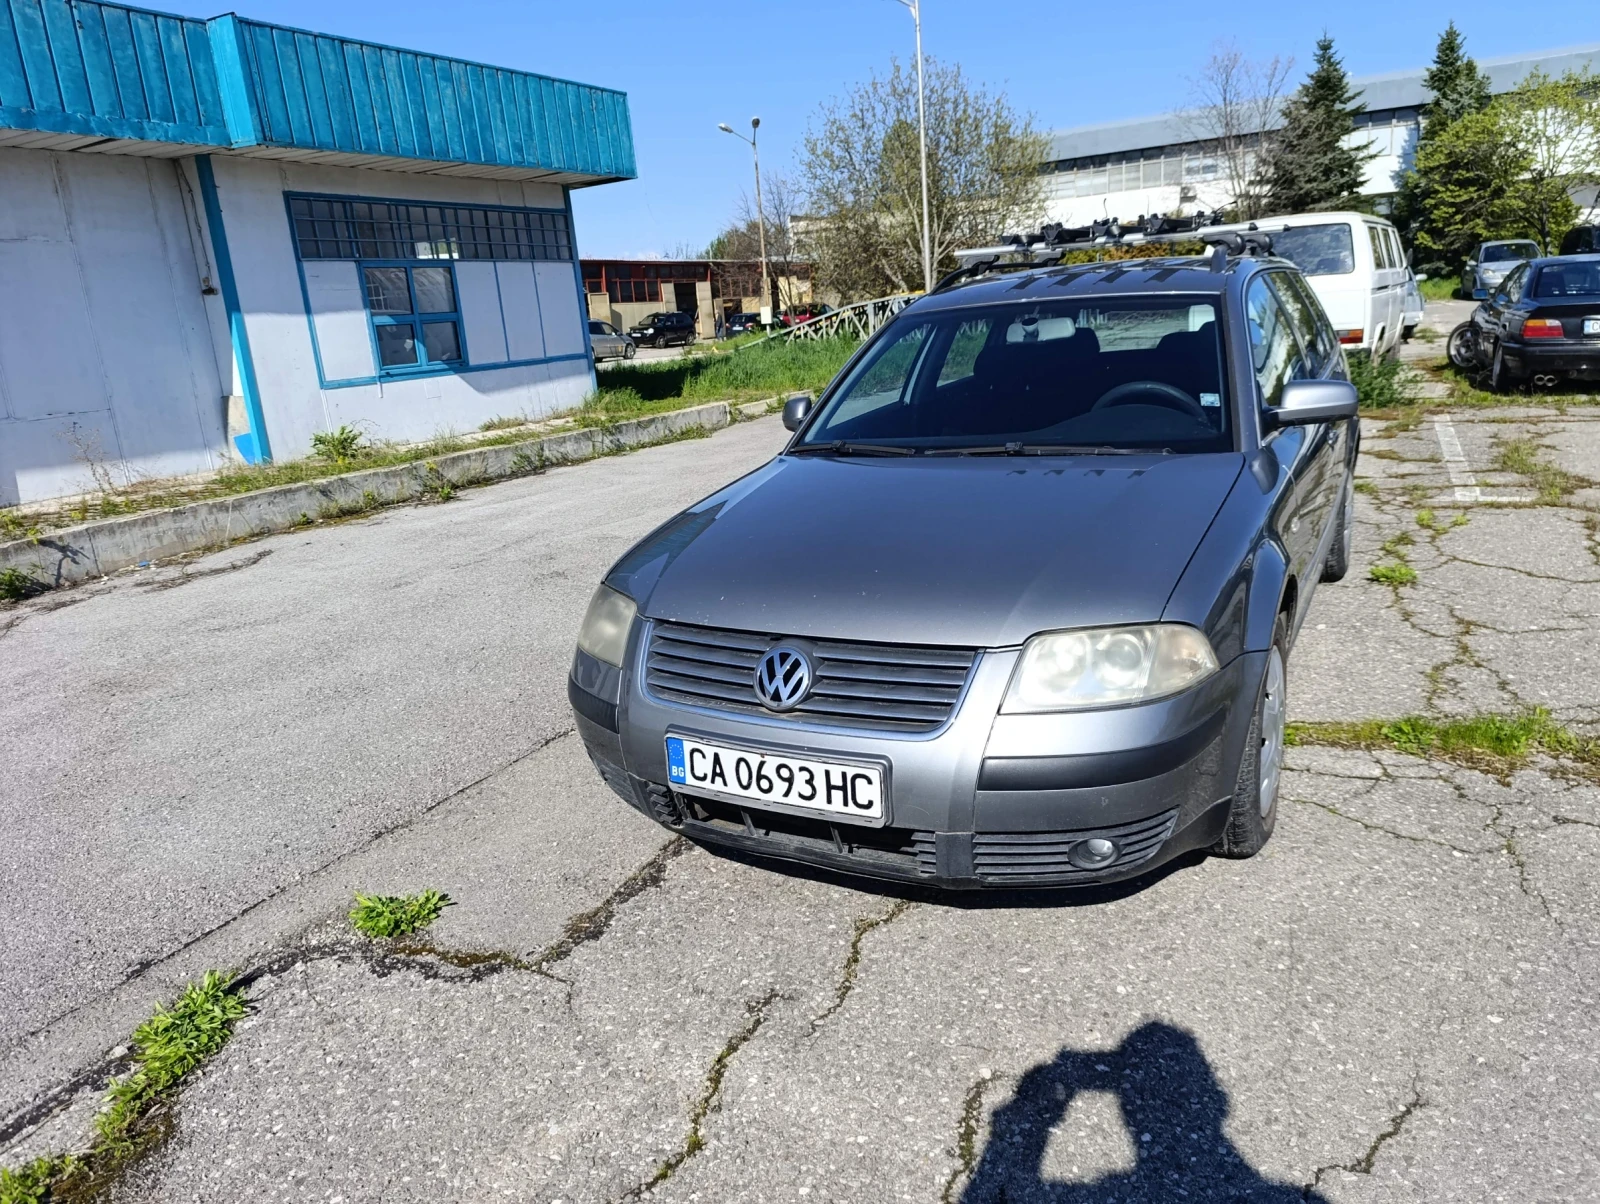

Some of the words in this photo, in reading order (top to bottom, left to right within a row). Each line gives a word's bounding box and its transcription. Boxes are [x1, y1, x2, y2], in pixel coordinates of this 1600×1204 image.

[671, 765, 685, 777] BG
[689, 747, 728, 787] CA
[735, 756, 817, 801] 0693
[824, 769, 874, 810] HC
